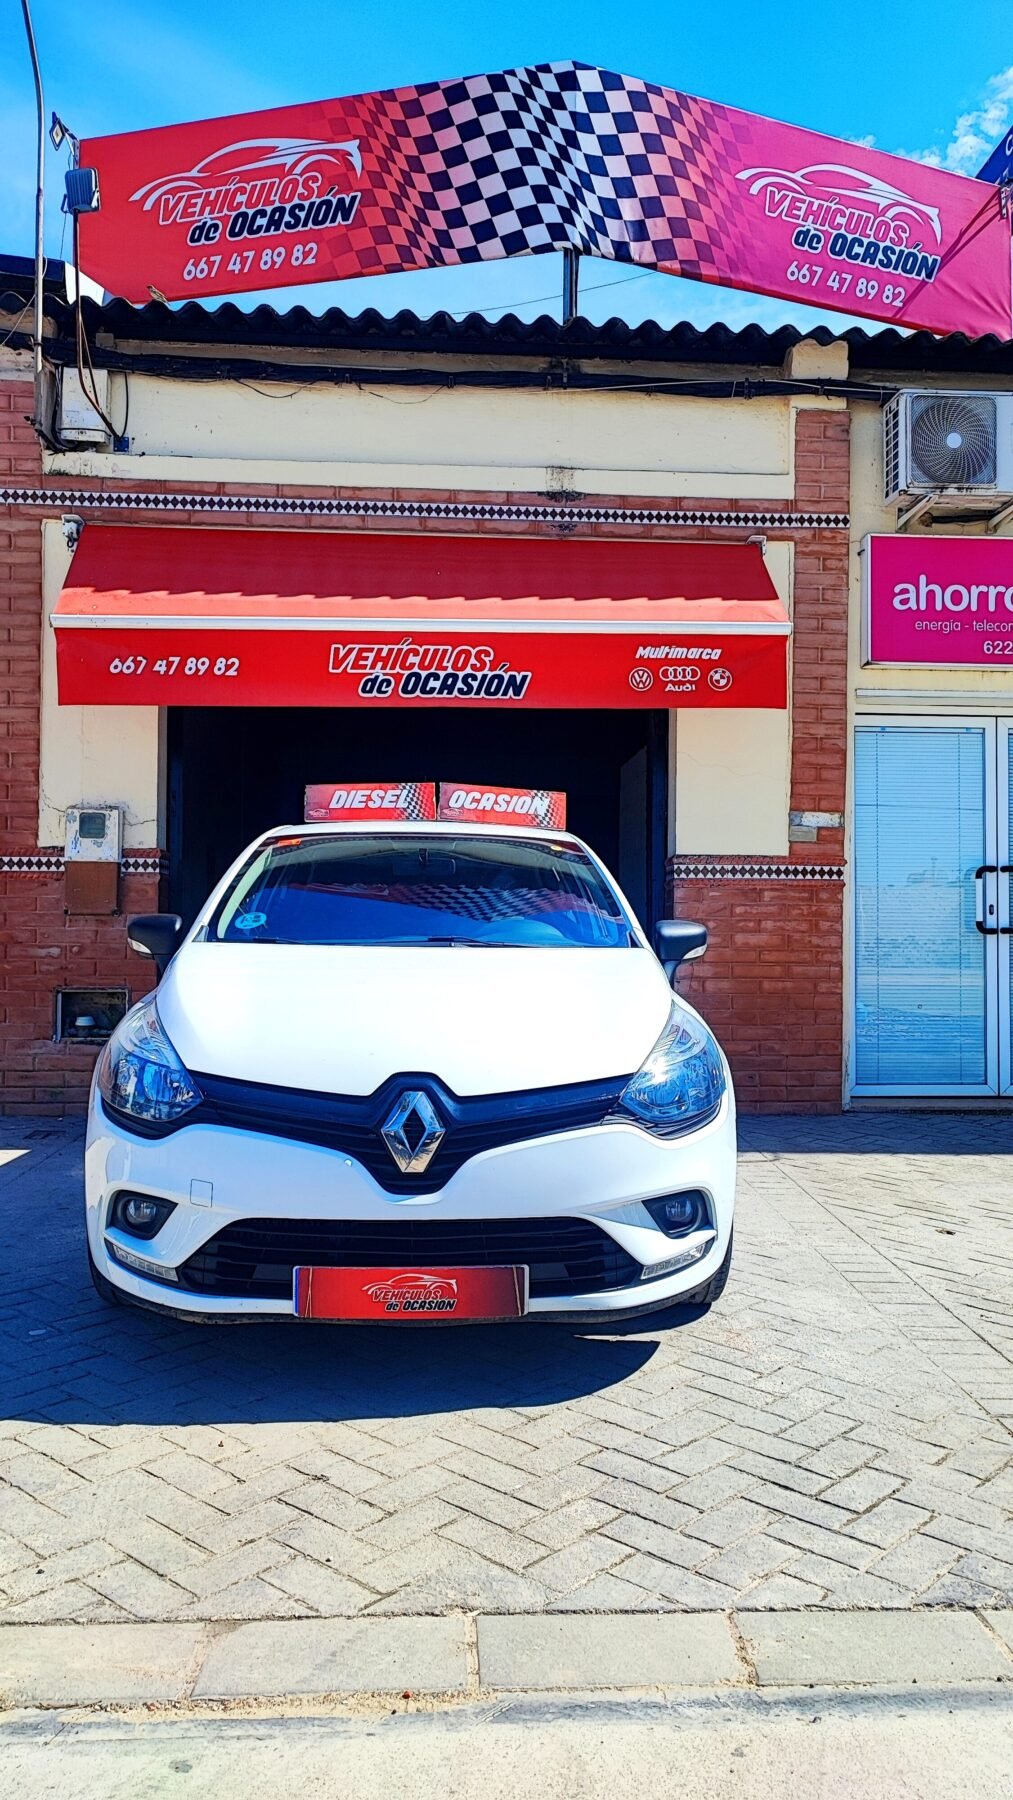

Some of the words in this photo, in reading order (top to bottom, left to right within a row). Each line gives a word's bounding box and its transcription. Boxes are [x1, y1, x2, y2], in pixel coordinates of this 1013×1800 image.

[159, 173, 322, 225] VEHÍCULOS
[187, 217, 223, 246] de
[225, 187, 362, 242] OCASIÓN
[765, 187, 911, 247] VEHÍCULOS
[183, 253, 223, 281] 667
[227, 250, 254, 275] 47
[260, 247, 286, 271] 89
[291, 242, 318, 267] 82
[792, 225, 824, 251] de
[828, 231, 941, 283] OCASIÓN
[786, 260, 823, 287] 667
[826, 270, 854, 294] 47
[855, 278, 879, 300] 89
[882, 285, 906, 307] 82
[915, 619, 961, 634] energía
[109, 656, 147, 675] 667
[153, 656, 181, 675] 47
[184, 656, 210, 676] 89
[213, 657, 240, 676] 82
[329, 638, 495, 673] VEHÍCULOS
[635, 645, 722, 660] Multimarca
[358, 672, 395, 697] de
[399, 663, 532, 699] OCASIÓN
[665, 683, 696, 692] Audi
[329, 789, 409, 809] DIESEL
[448, 790, 551, 817] OCASION
[372, 1287, 441, 1302] VEHÍCULOS
[385, 1301, 400, 1312] de
